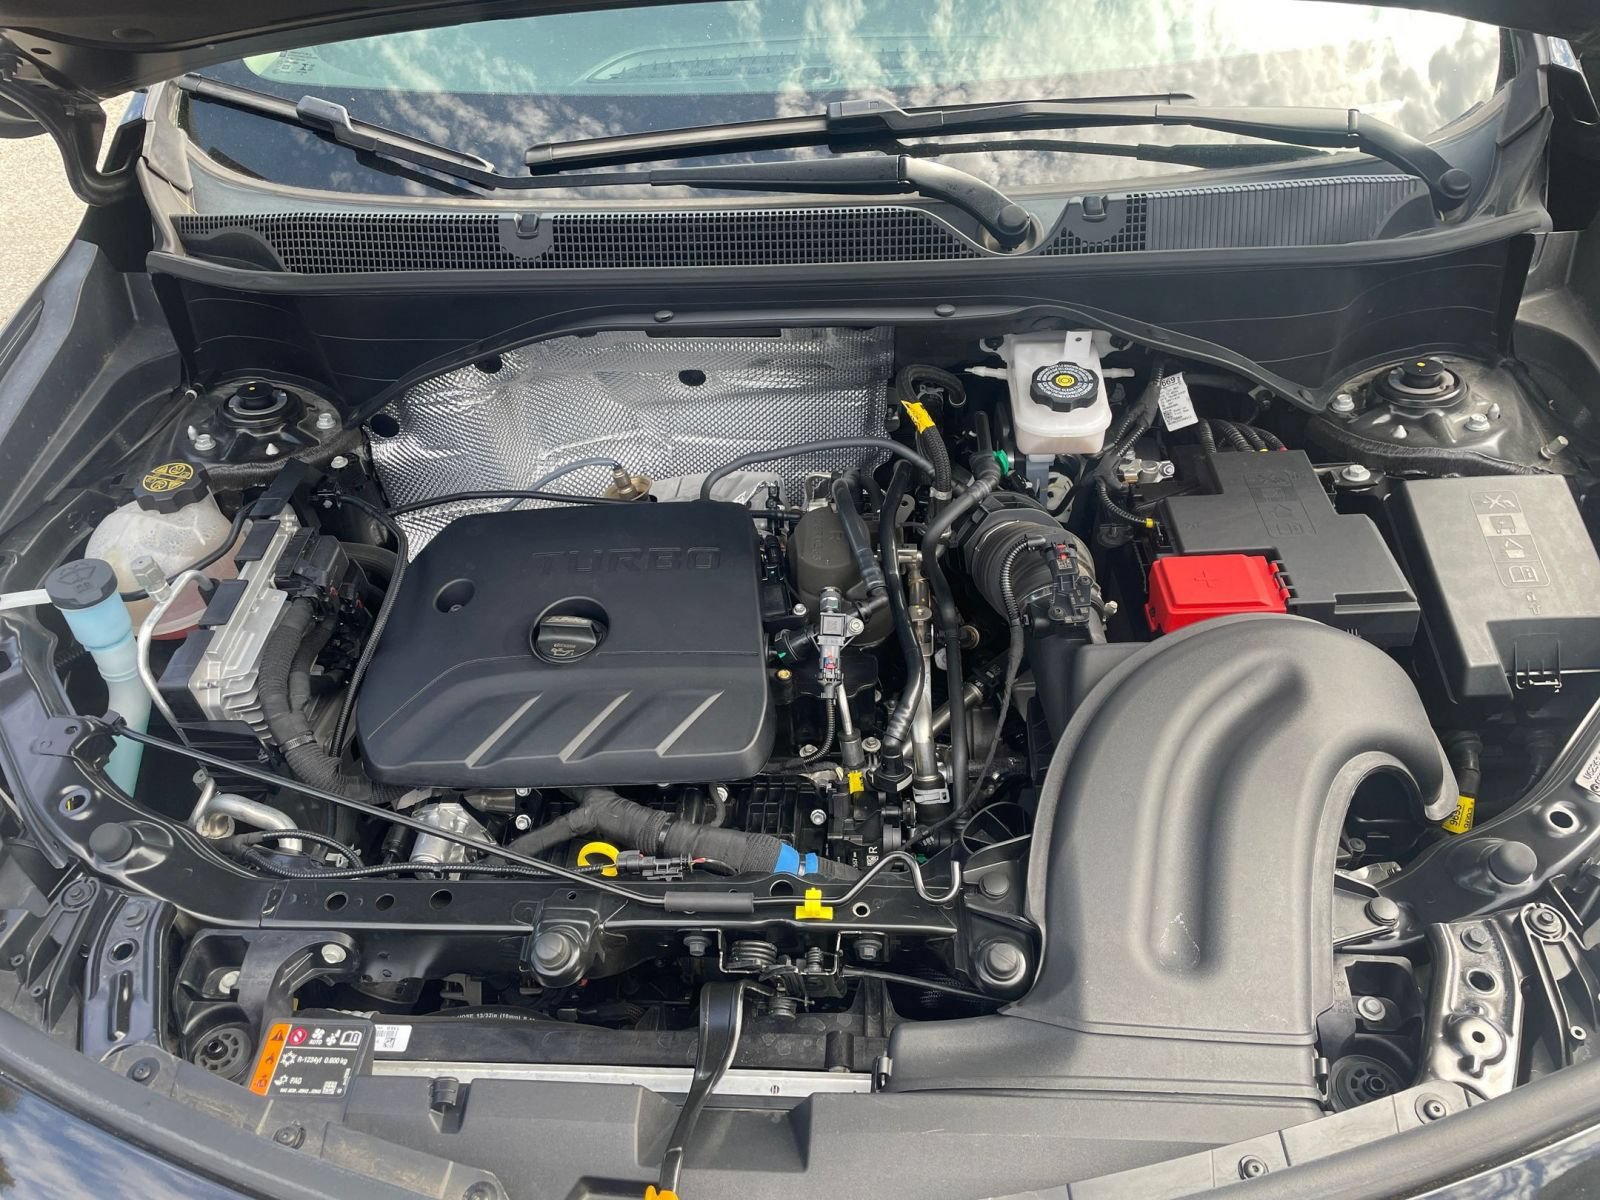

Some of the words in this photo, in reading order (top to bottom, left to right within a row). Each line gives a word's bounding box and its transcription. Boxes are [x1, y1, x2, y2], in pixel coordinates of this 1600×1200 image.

[532, 546, 722, 576] TURBO
[868, 846, 878, 854] R
[297, 1055, 323, 1065] R-1234yf
[340, 1057, 349, 1066] kg
